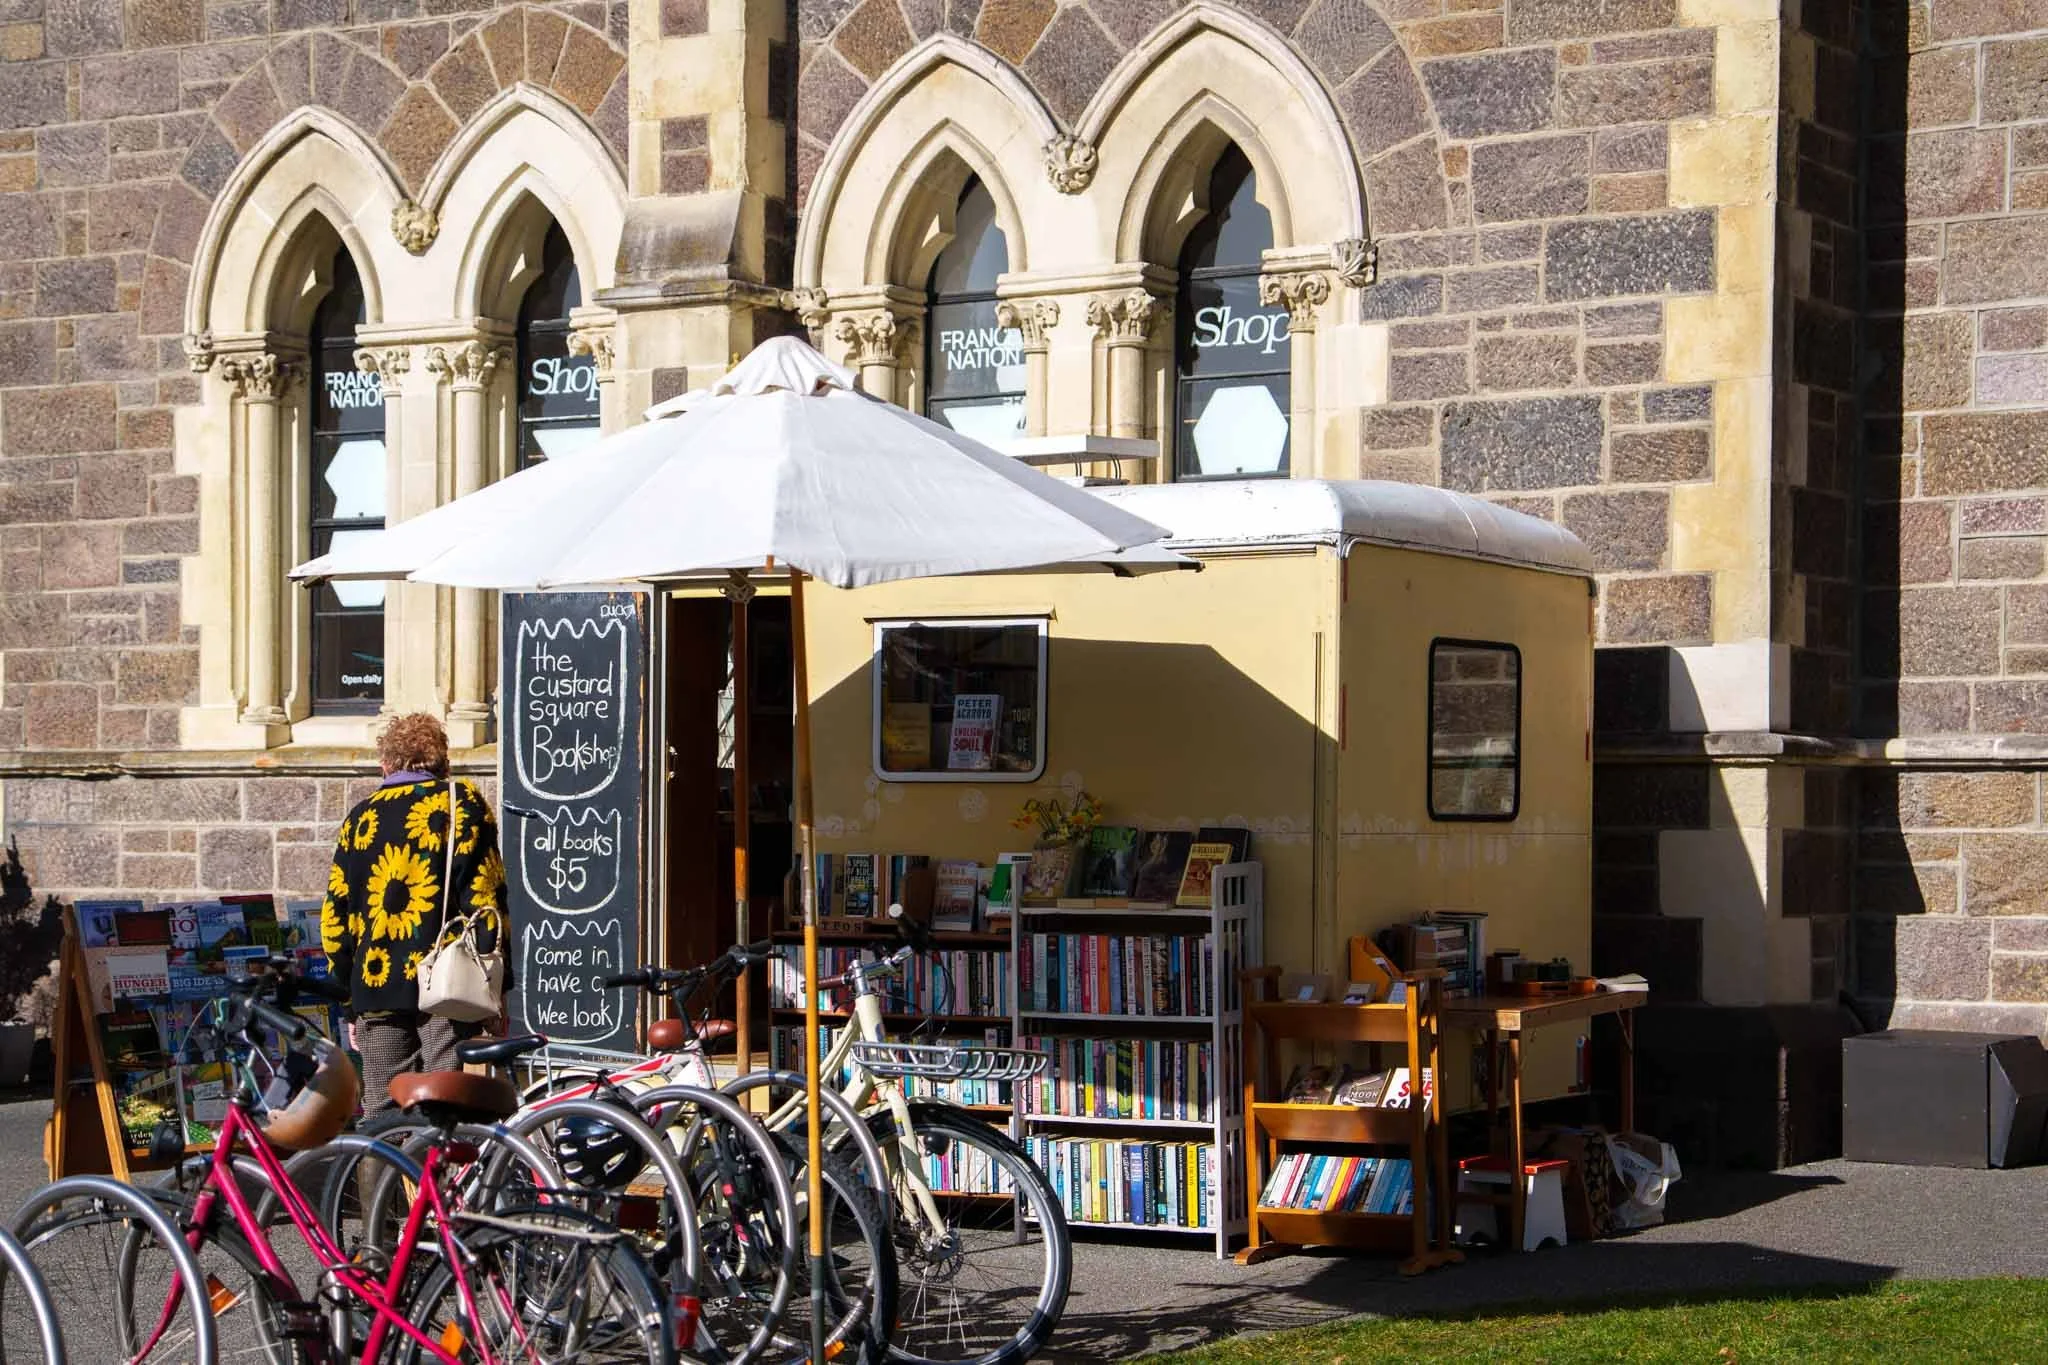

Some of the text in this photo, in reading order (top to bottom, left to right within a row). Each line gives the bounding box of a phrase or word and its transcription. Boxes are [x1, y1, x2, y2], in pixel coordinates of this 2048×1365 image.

[1192, 306, 1291, 354] Shop
[948, 347, 1020, 371] NATION
[531, 641, 573, 672] the
[342, 674, 382, 686] Open daily
[957, 699, 992, 707] PETER
[534, 826, 613, 856] all books
[547, 850, 589, 900] $5
[535, 947, 583, 966] Come
[115, 978, 168, 988] HUNGER
[172, 979, 191, 987] BIG
[537, 968, 582, 993] have
[573, 997, 614, 1027] look
[1350, 1090, 1378, 1099] MOON
